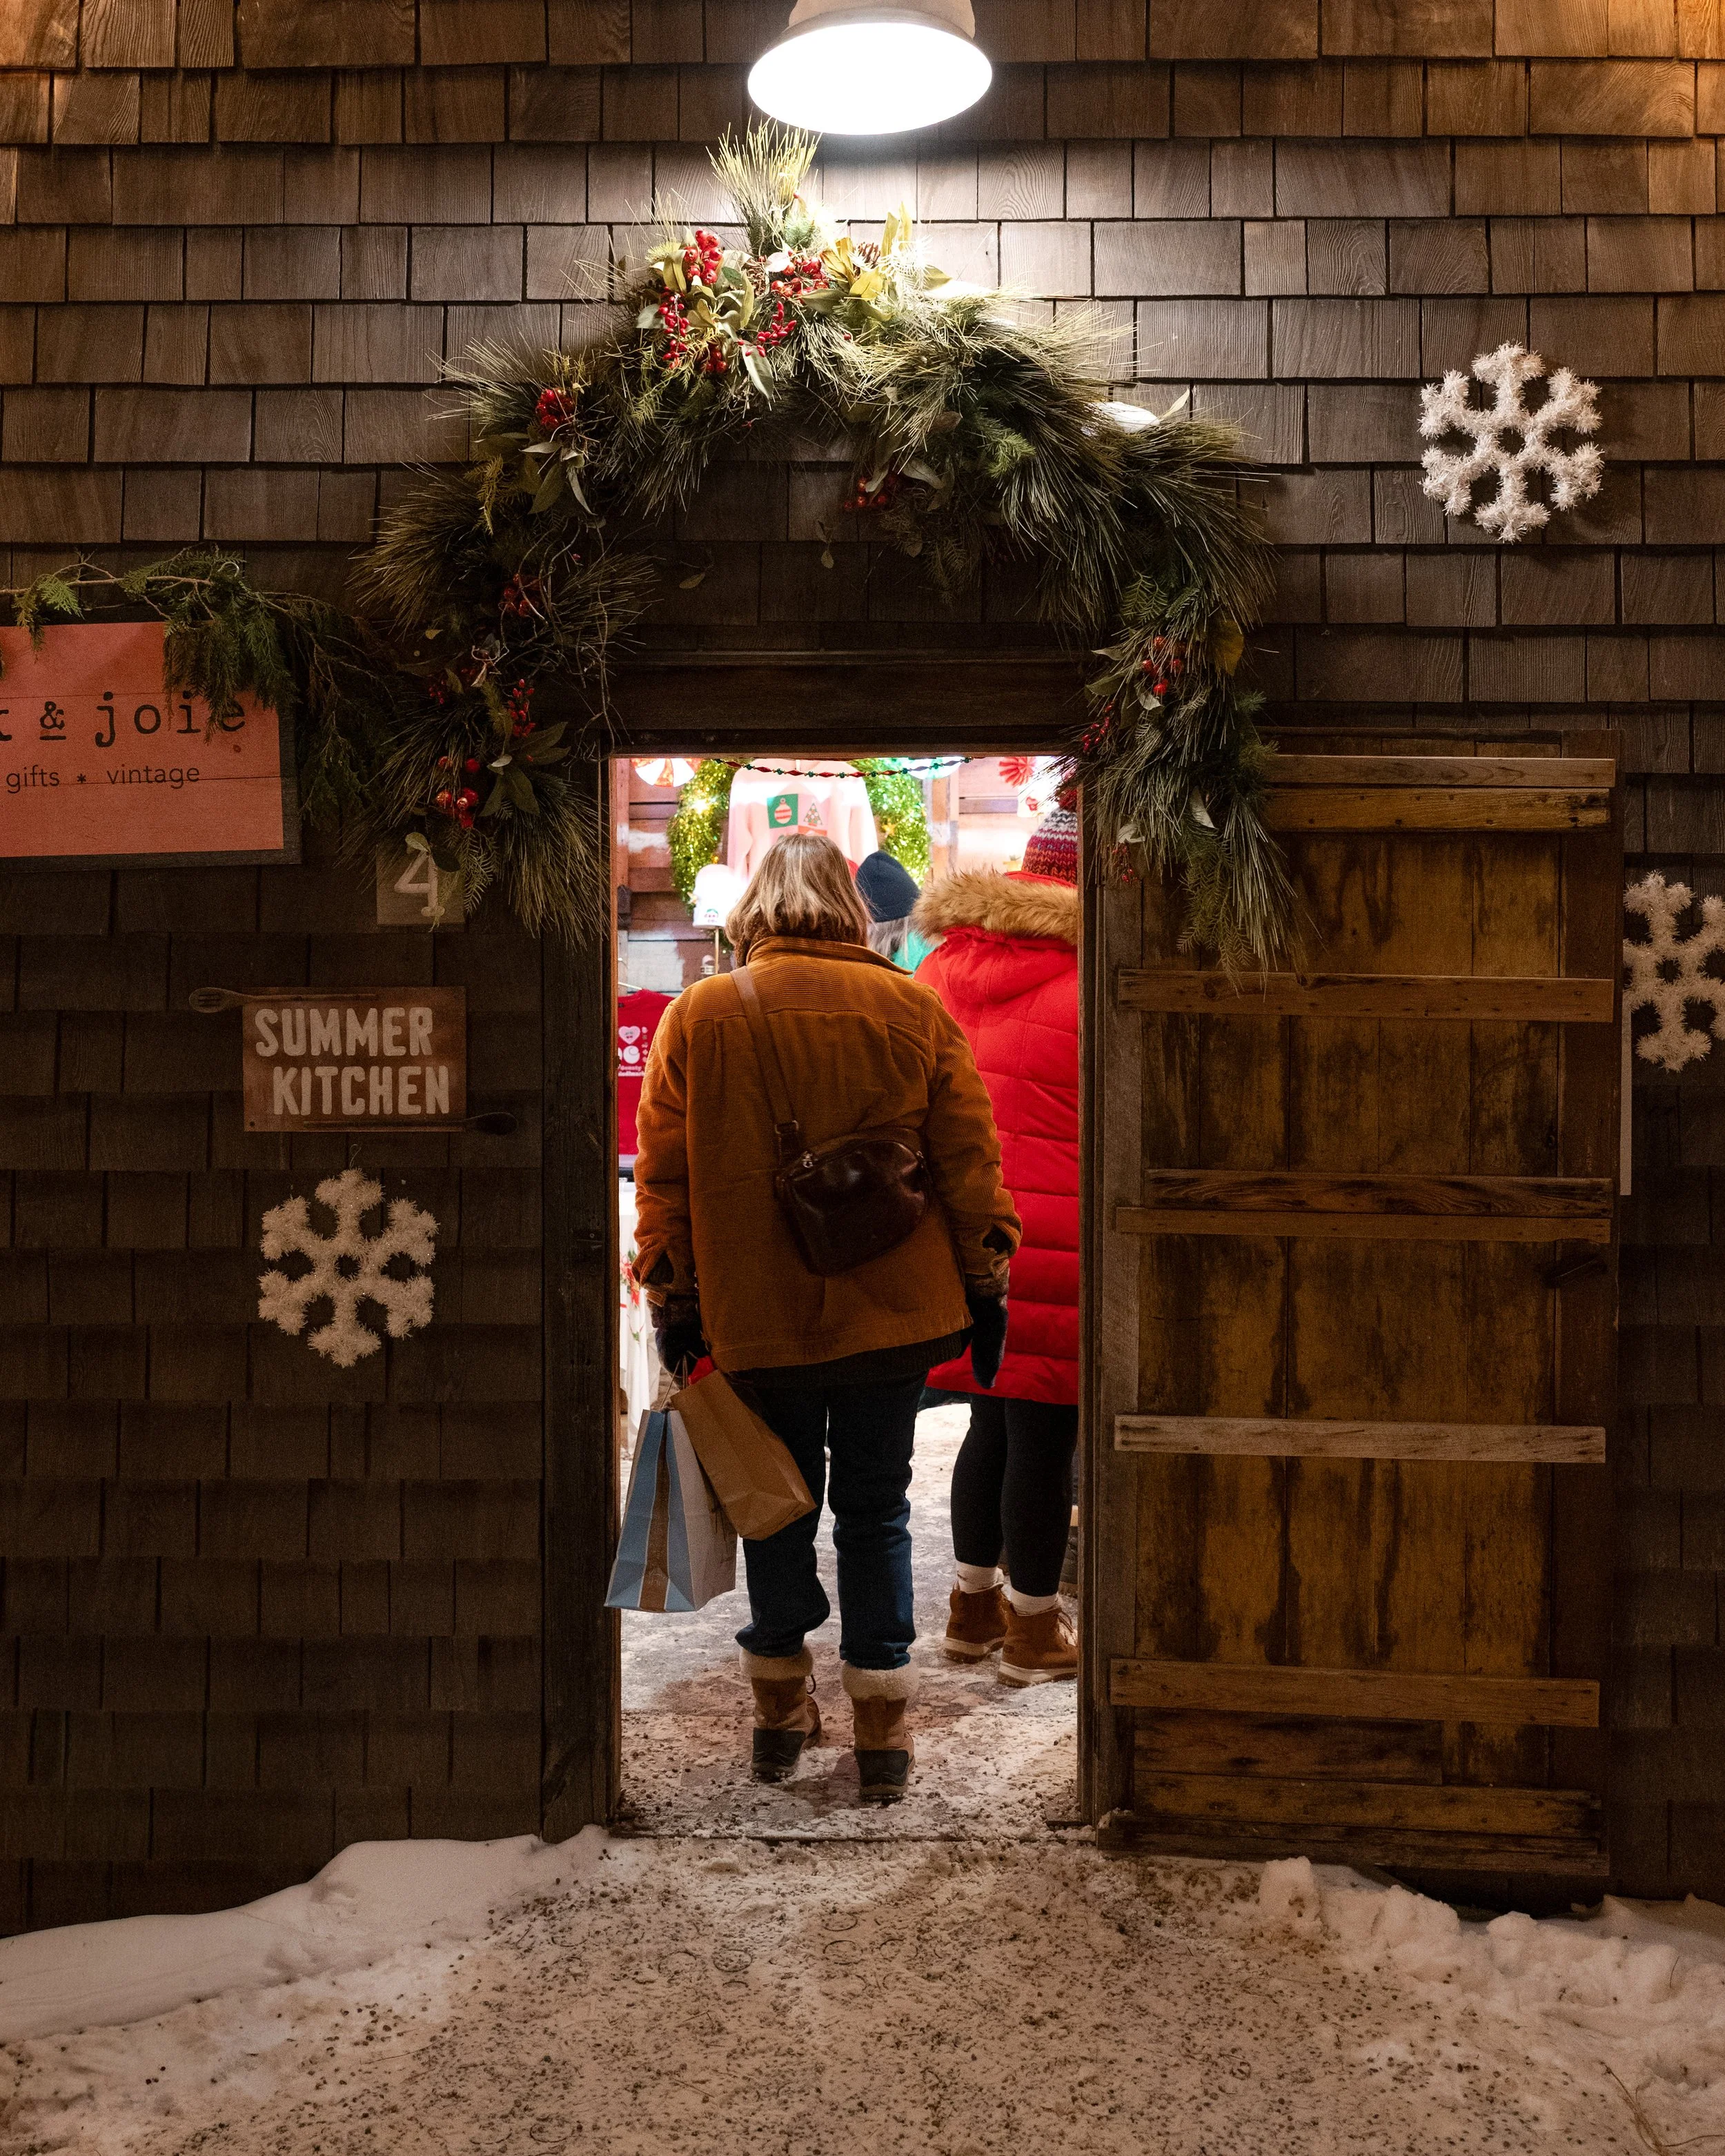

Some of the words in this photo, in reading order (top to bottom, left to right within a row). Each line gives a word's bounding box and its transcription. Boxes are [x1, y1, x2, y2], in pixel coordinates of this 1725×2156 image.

[39, 701, 67, 740] &
[95, 691, 246, 748] joie
[6, 765, 60, 793] gifts
[107, 764, 200, 789] vintage
[393, 849, 445, 917] 4
[255, 1007, 433, 1056] SUMMER
[273, 1066, 449, 1116] KITCHEN
